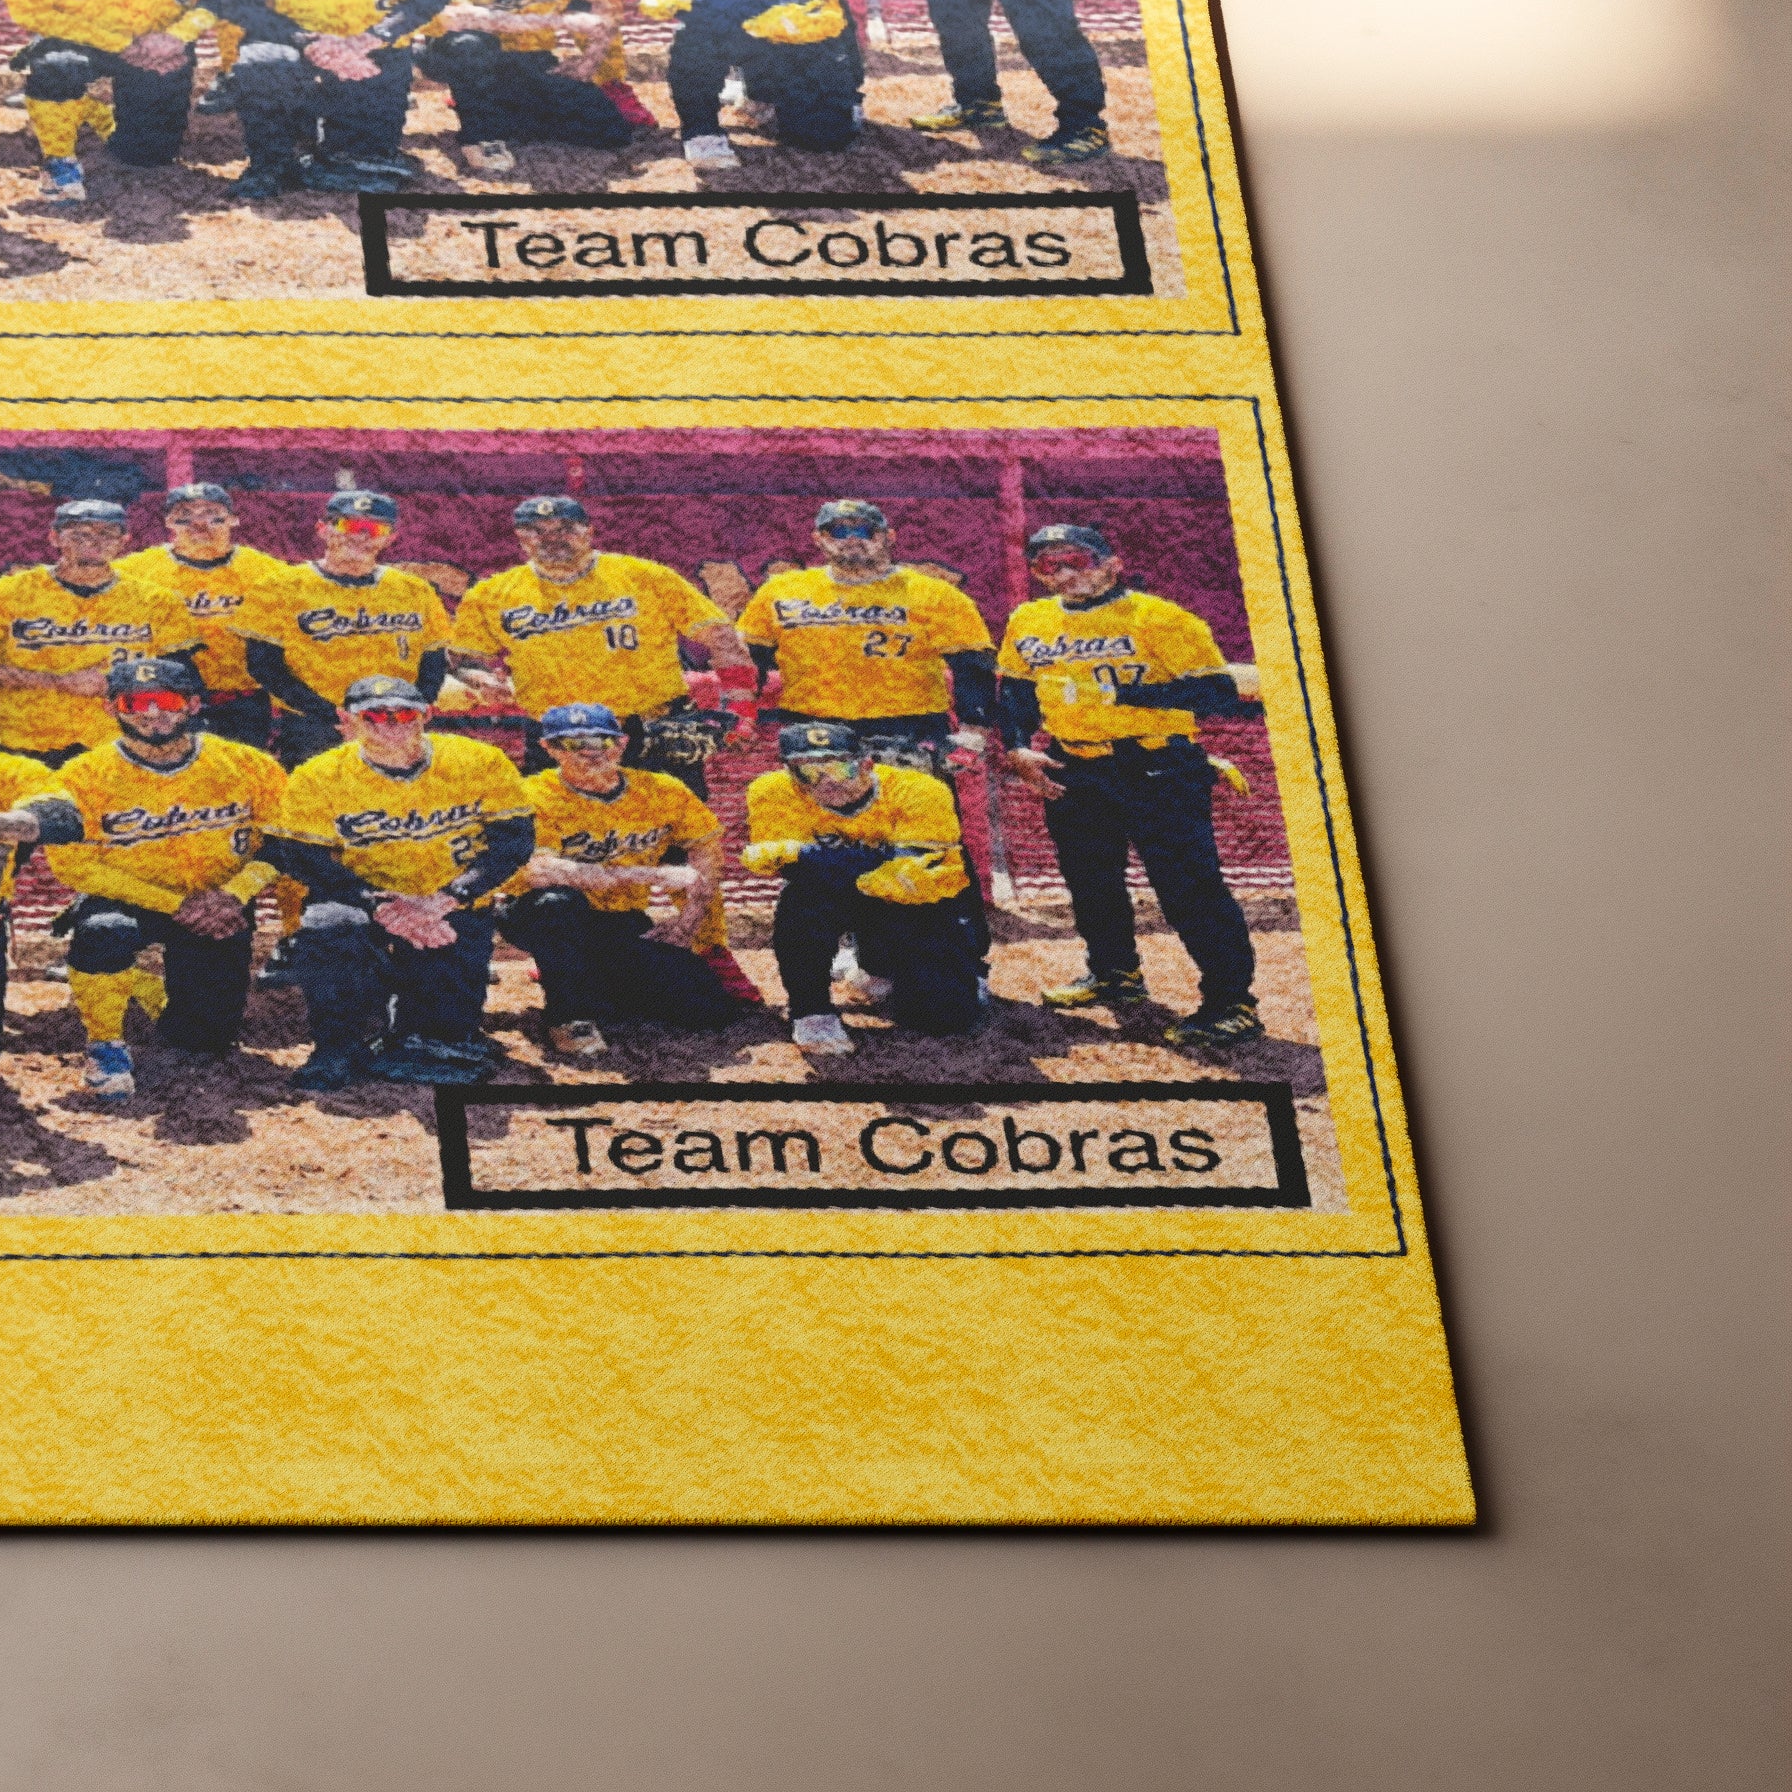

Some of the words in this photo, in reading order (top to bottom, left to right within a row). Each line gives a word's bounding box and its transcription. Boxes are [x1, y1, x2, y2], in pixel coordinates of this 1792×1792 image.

[461, 220, 708, 269] Team
[742, 219, 1072, 270] Cobras
[604, 623, 639, 652] 10
[862, 629, 915, 658] 27
[545, 1116, 821, 1175] Team
[858, 1115, 1221, 1175] Cobras
